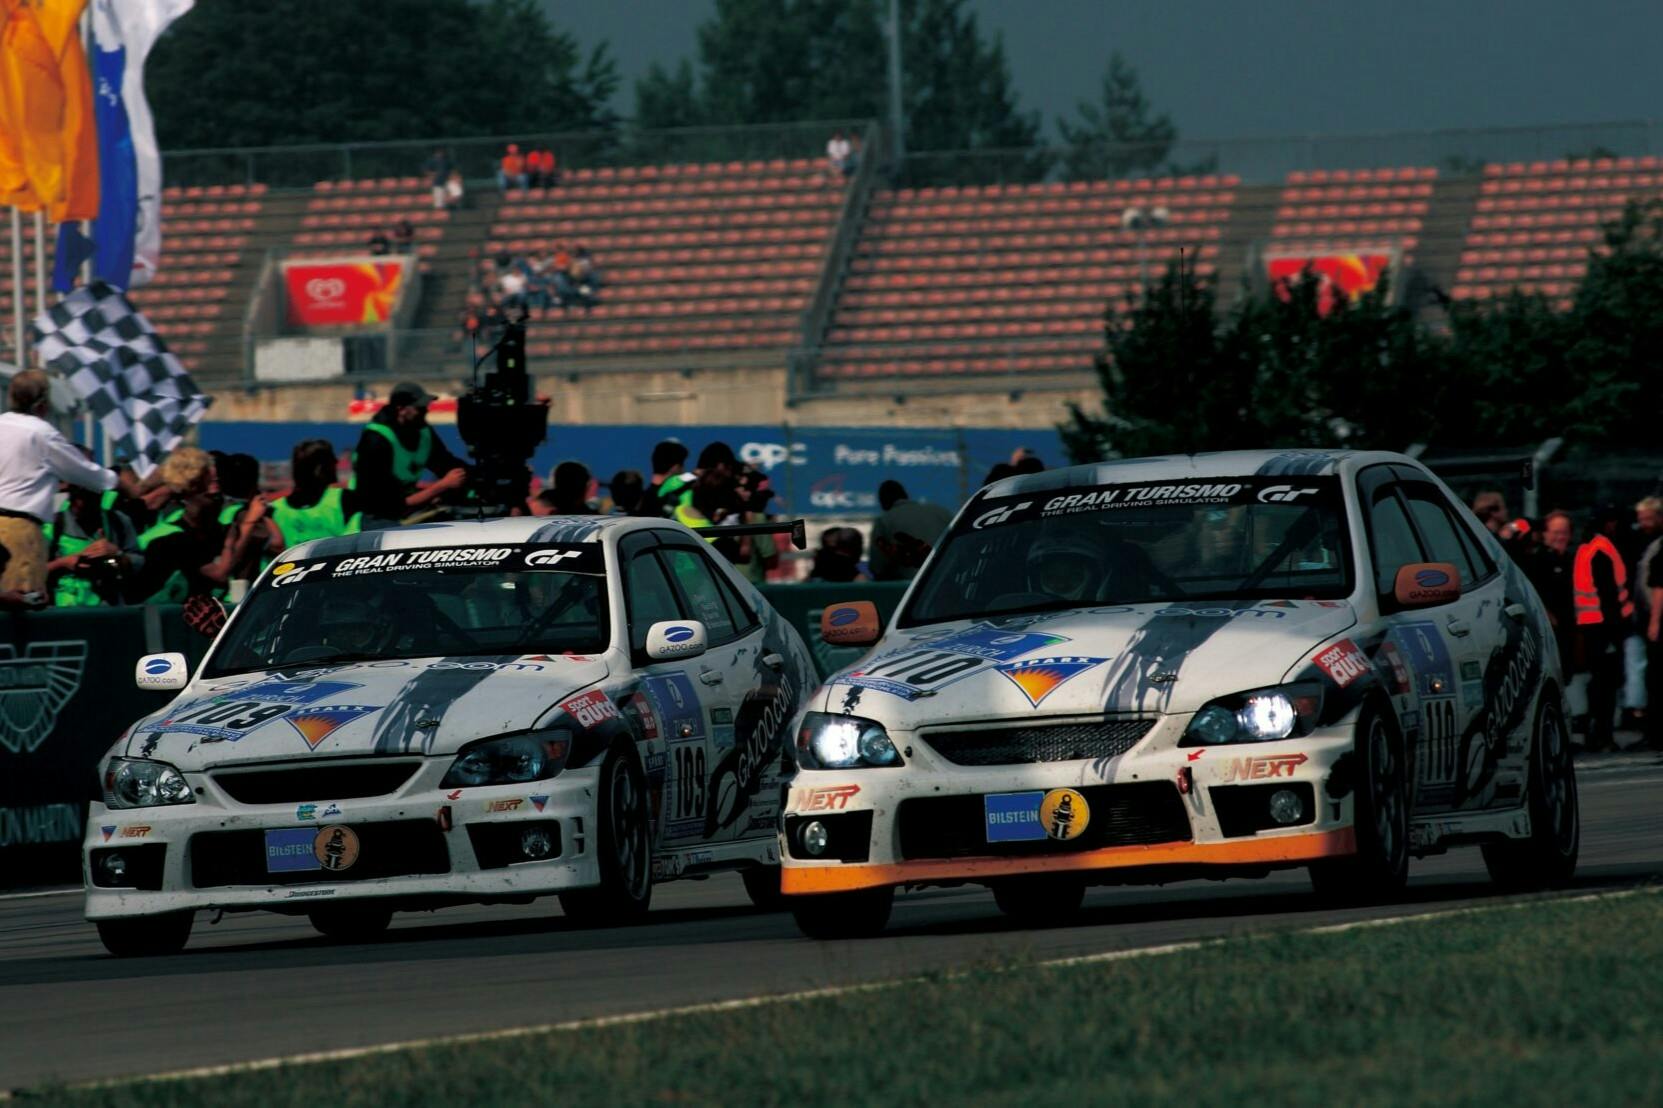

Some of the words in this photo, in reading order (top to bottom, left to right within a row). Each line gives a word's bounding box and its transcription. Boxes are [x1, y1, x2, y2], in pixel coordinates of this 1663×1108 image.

[1040, 509, 1063, 518] THE
[1066, 505, 1096, 514] REAL
[1101, 499, 1155, 510] DRIVING
[1156, 496, 1230, 506] SIMULATOR
[1043, 490, 1121, 511] GRAN
[1124, 484, 1242, 501] TURISMO
[331, 571, 351, 579] THE
[355, 566, 383, 576] REAL
[386, 562, 432, 571] DRIVING
[433, 560, 500, 568] SIMULATOR
[335, 553, 404, 573] GRAN
[406, 549, 512, 564] TURISMO
[864, 650, 984, 685] 110
[1013, 656, 1091, 668] SPARX
[174, 701, 292, 730] 109
[297, 704, 365, 715] SPARX
[1426, 700, 1455, 781] 110
[675, 747, 705, 818] 109
[988, 811, 1038, 824] BILSTEIN
[269, 844, 313, 857] BILSTEIN
